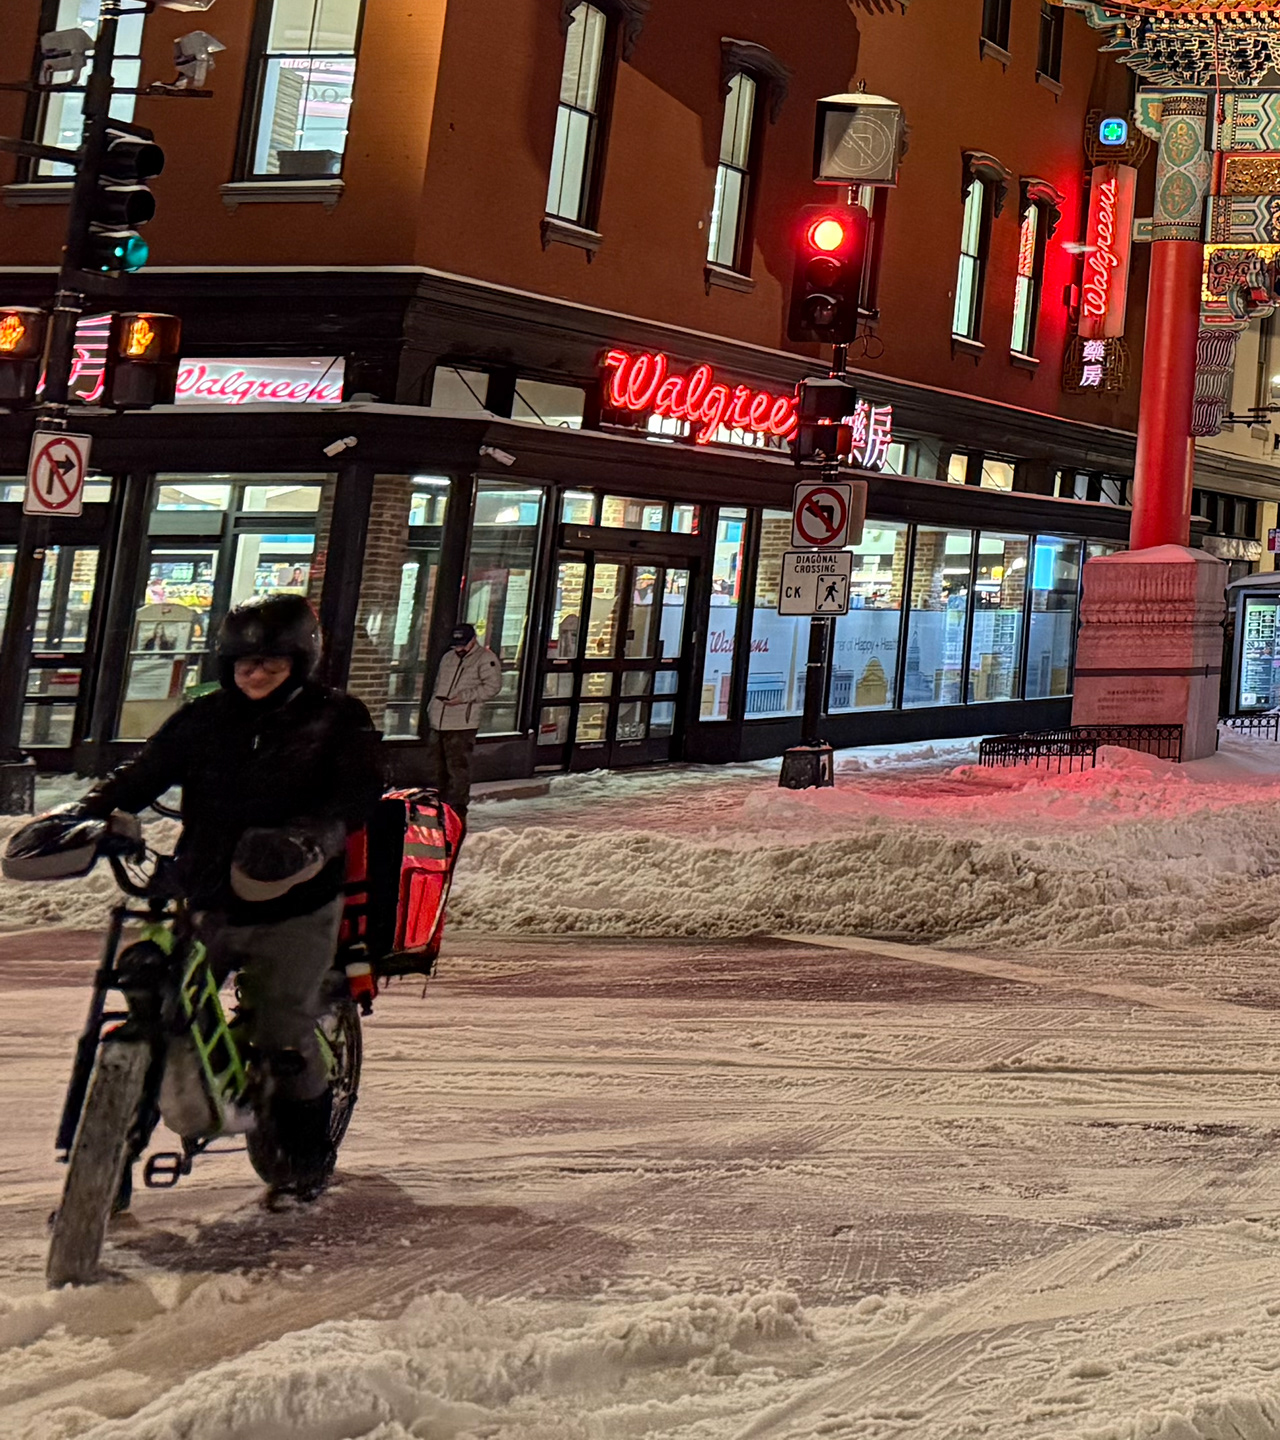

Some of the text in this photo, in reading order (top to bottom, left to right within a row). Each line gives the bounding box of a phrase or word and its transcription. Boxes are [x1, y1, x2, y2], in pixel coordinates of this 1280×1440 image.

[1084, 169, 1118, 317] Walgreens
[603, 348, 800, 445] Walgree
[796, 555, 837, 564] DIAGONAL
[795, 565, 835, 573] CROSSING
[785, 586, 801, 598] CK
